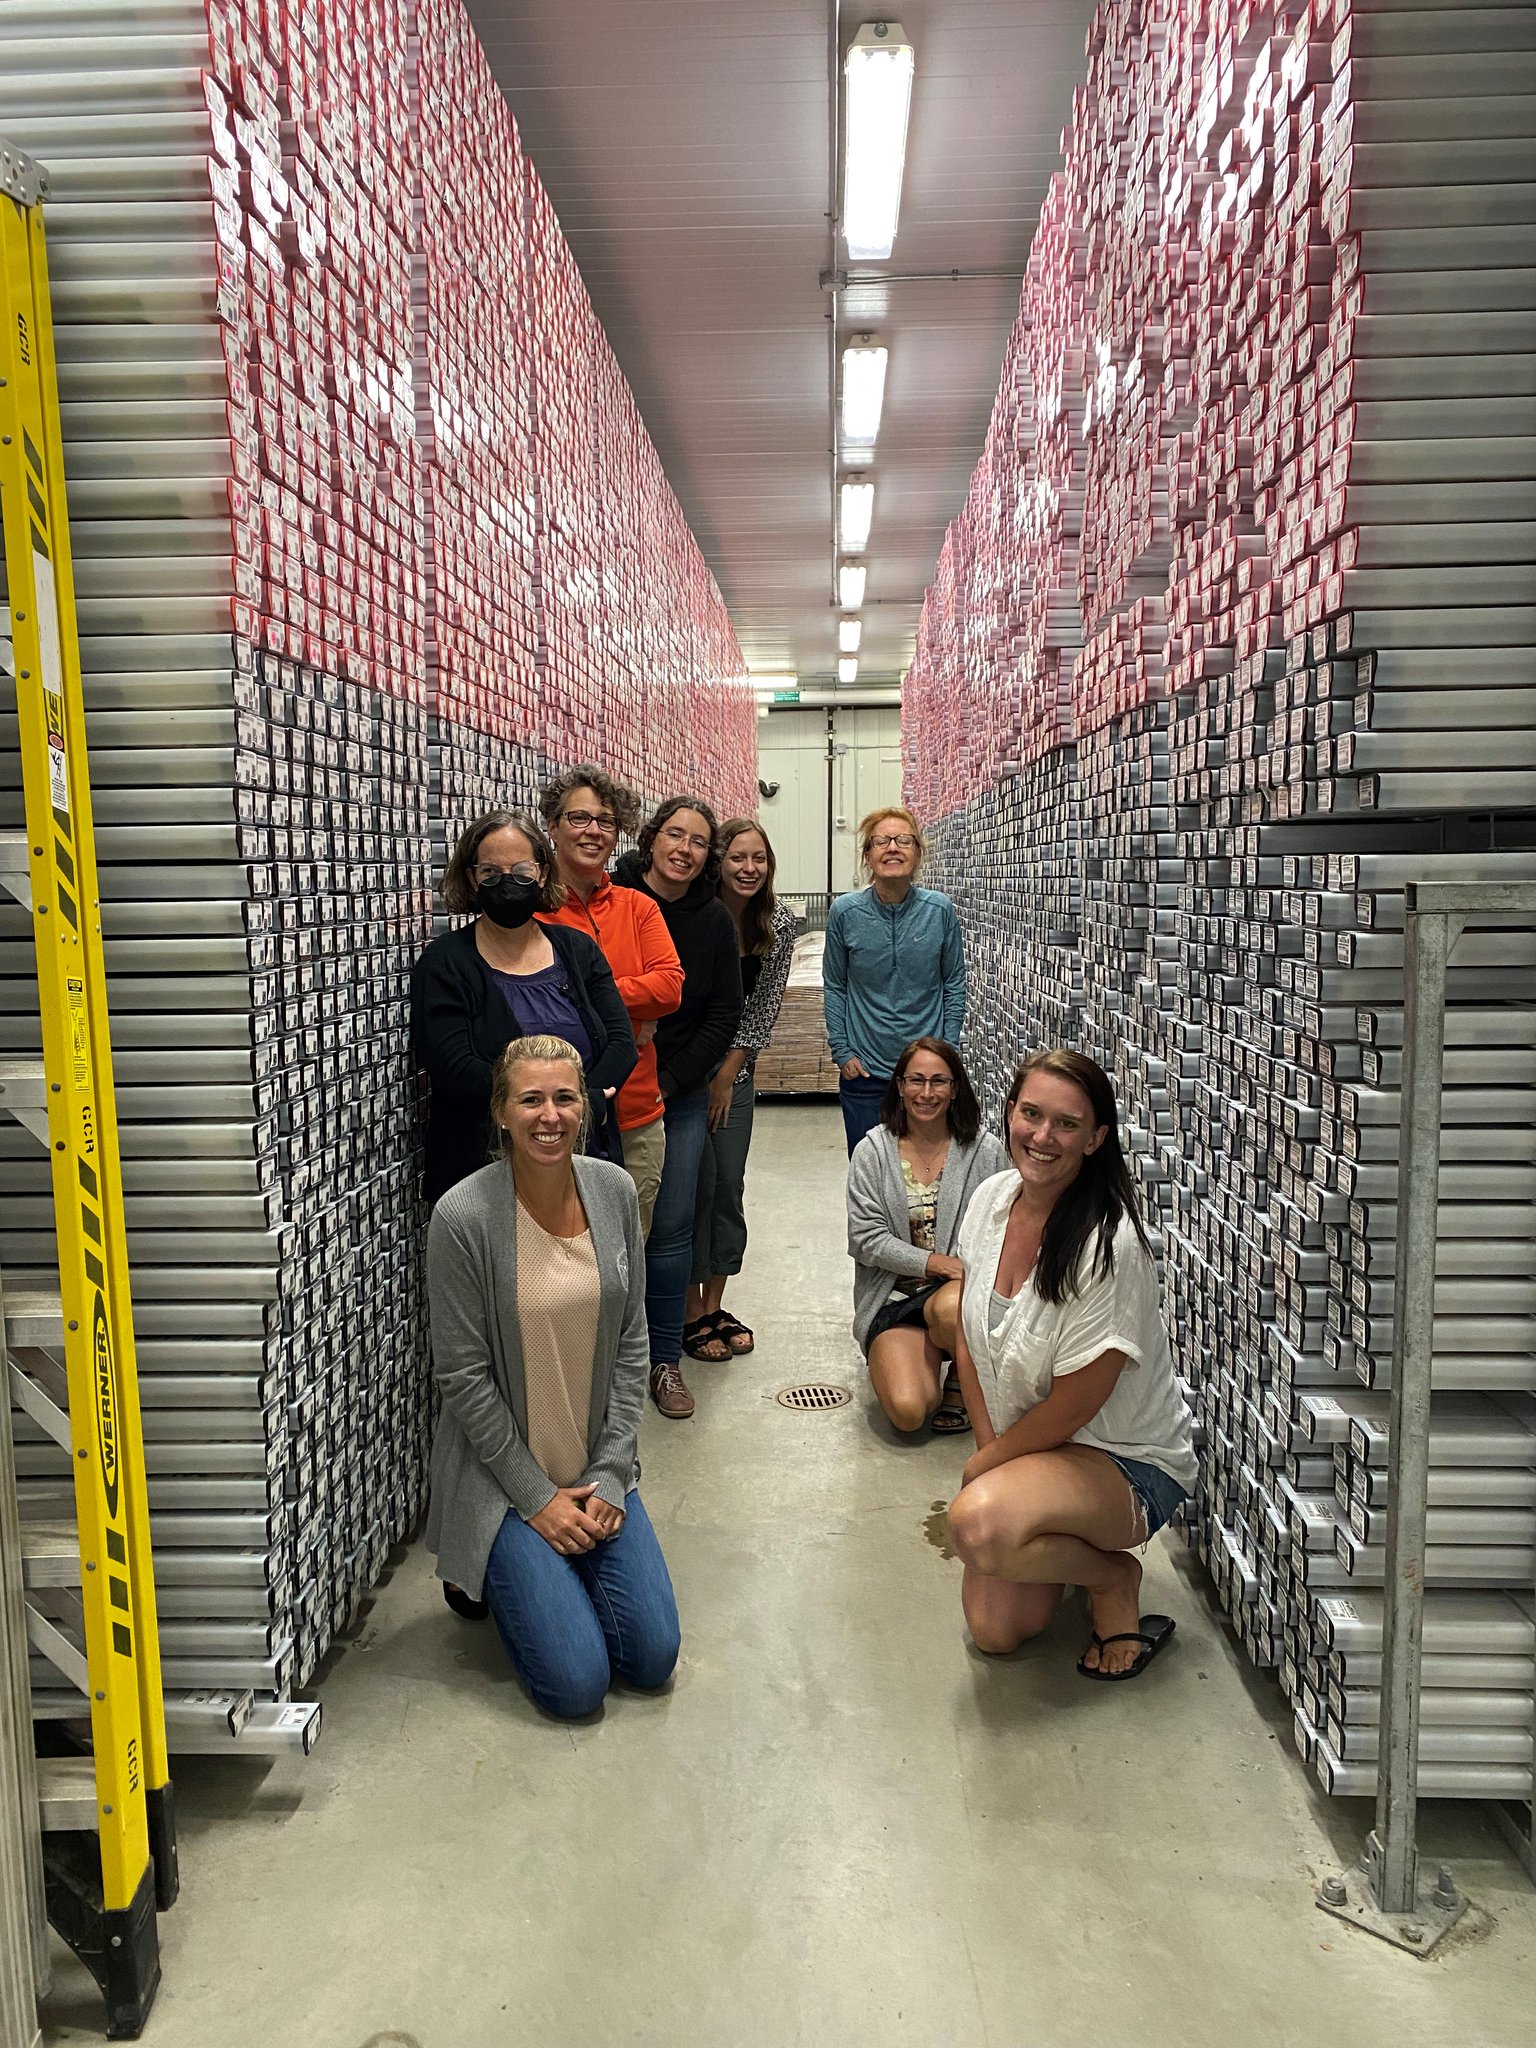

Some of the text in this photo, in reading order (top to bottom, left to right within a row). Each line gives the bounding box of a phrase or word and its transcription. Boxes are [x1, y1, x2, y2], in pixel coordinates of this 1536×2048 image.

[82, 1105, 95, 1154] GCR
[97, 1330, 115, 1470] WERNER
[127, 1738, 139, 1793] GCR
